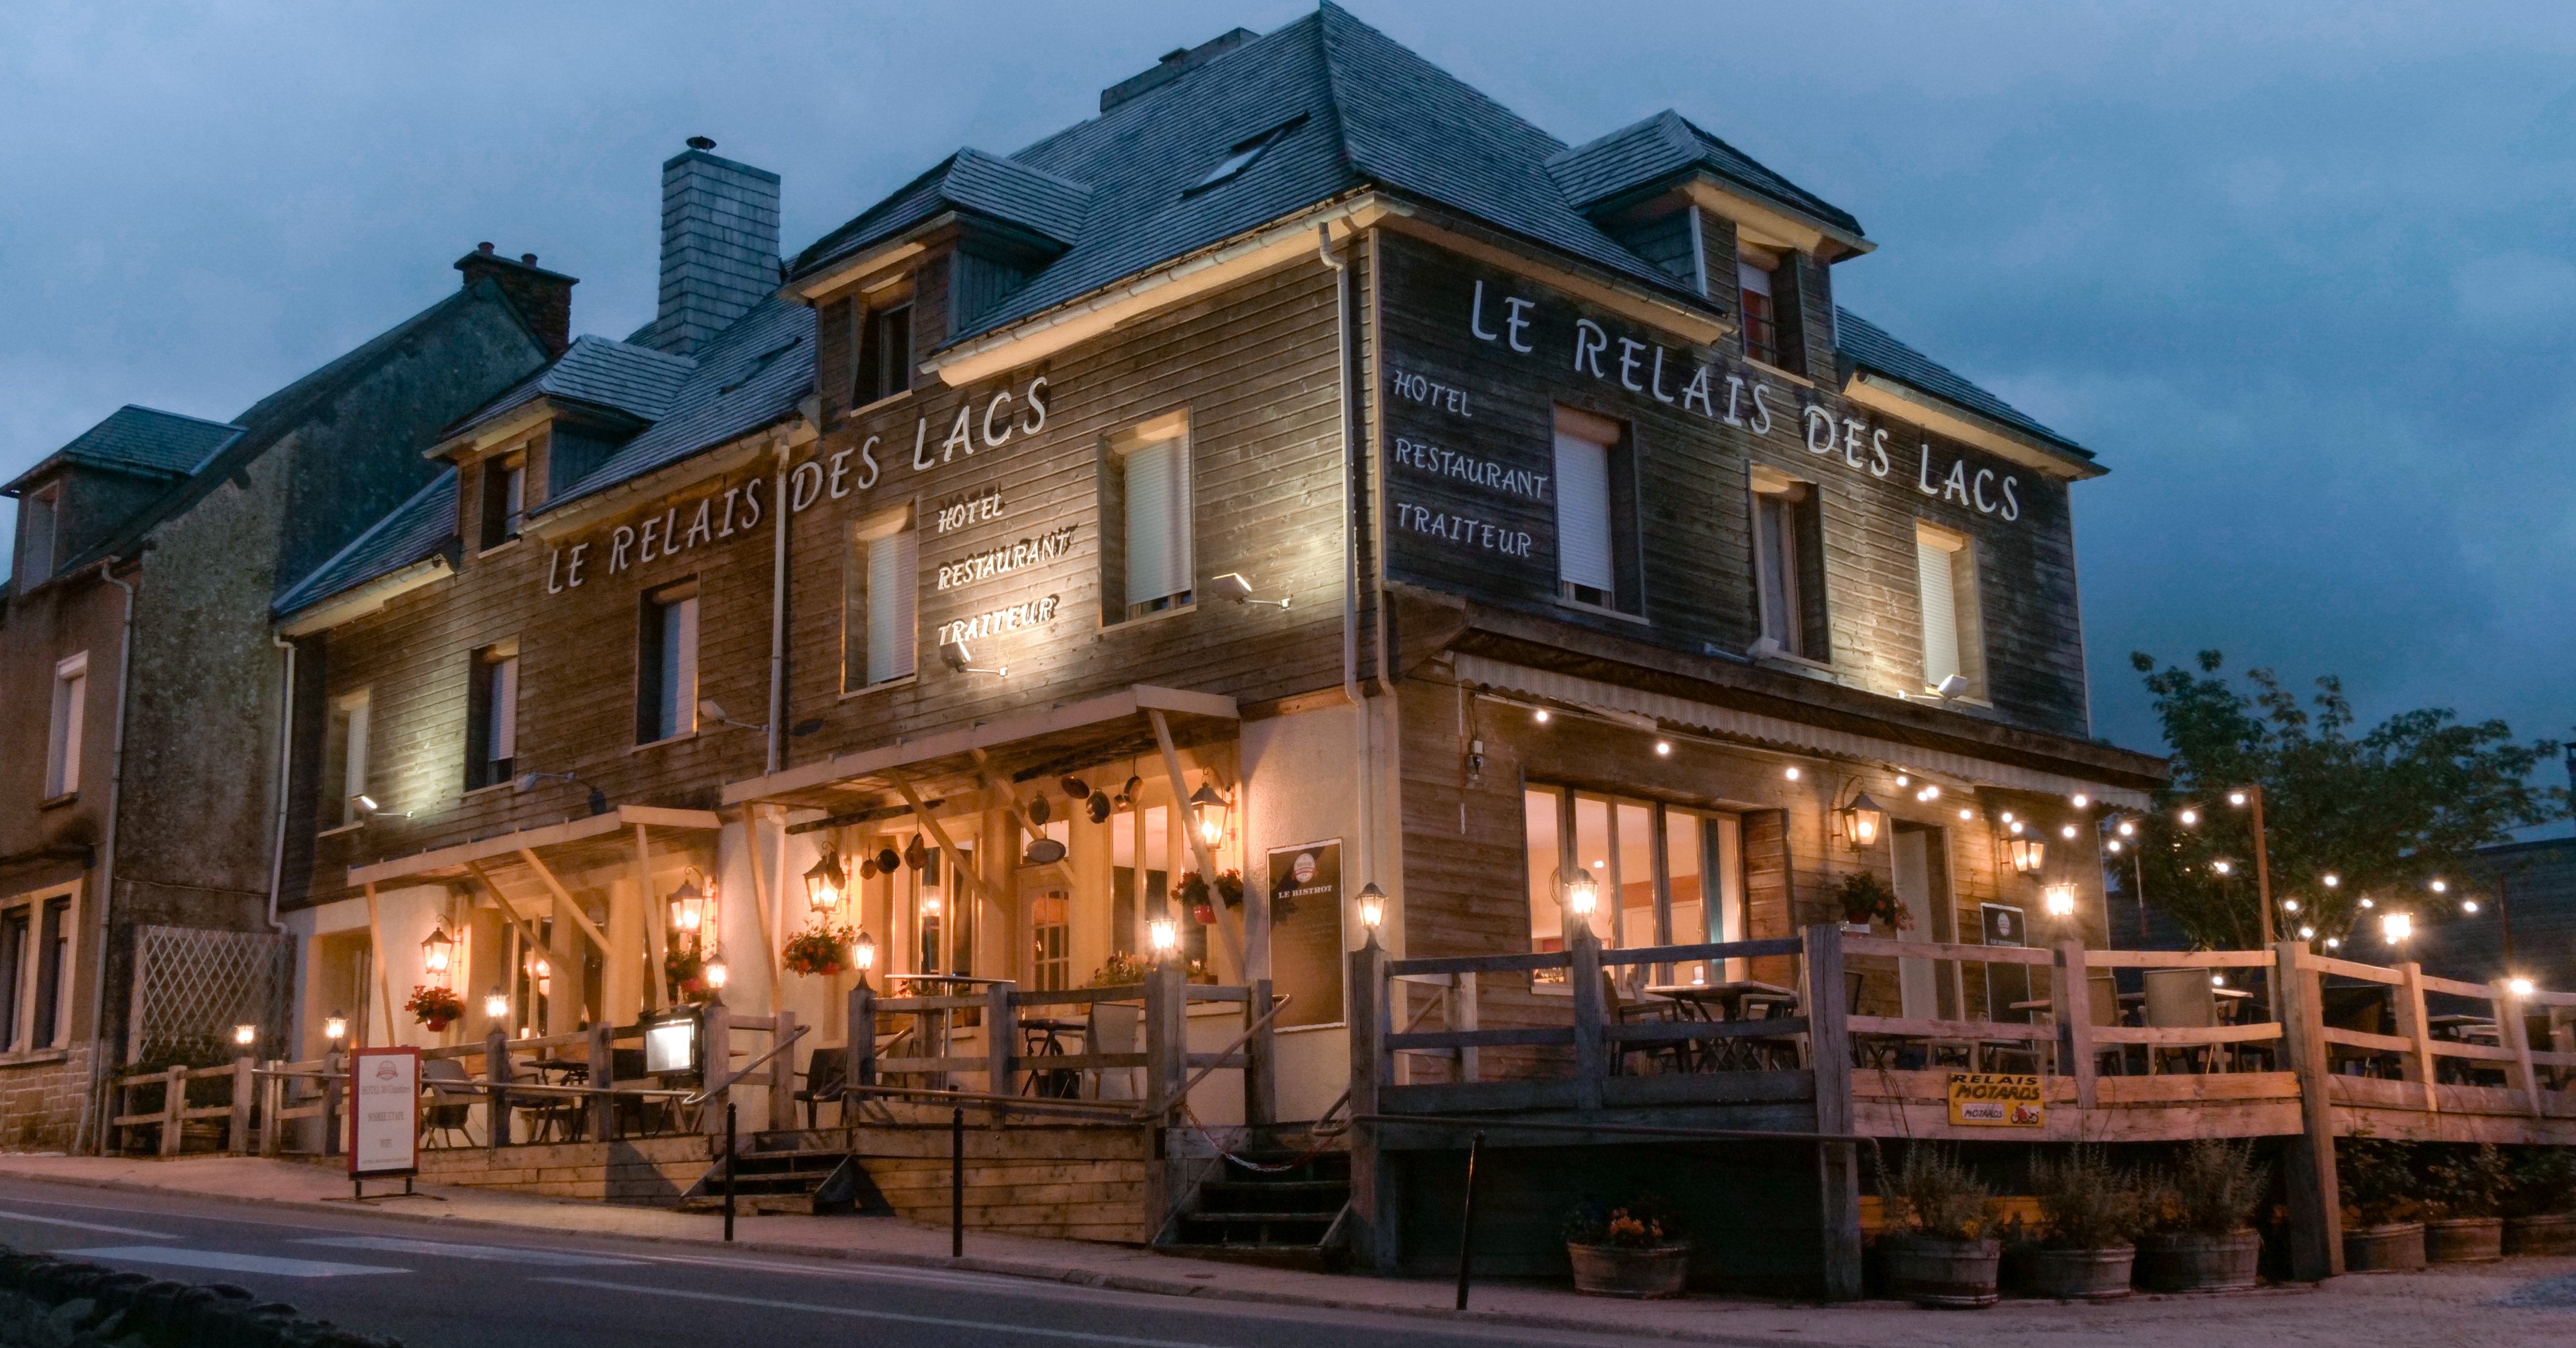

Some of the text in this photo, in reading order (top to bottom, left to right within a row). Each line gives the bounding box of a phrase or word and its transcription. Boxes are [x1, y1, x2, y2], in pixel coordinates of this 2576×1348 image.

[1394, 369, 1473, 418] HOTEL
[1471, 279, 2019, 521] LE RELAIS DES LACS
[548, 377, 1047, 594] LE RELAIS DES LACS
[1396, 438, 1548, 500] RESTAURANT
[938, 493, 1003, 533] HOTEL
[1397, 503, 1532, 558] TRAITEUR
[938, 531, 1074, 591] RESTAURANT
[939, 597, 1055, 647] TRAITEUR
[1292, 885, 1332, 897] BISTROT
[1952, 1075, 2037, 1085] RELAIS
[1955, 1085, 2040, 1100] MOTARDS
[1964, 1109, 2003, 1118] MOTARDS
